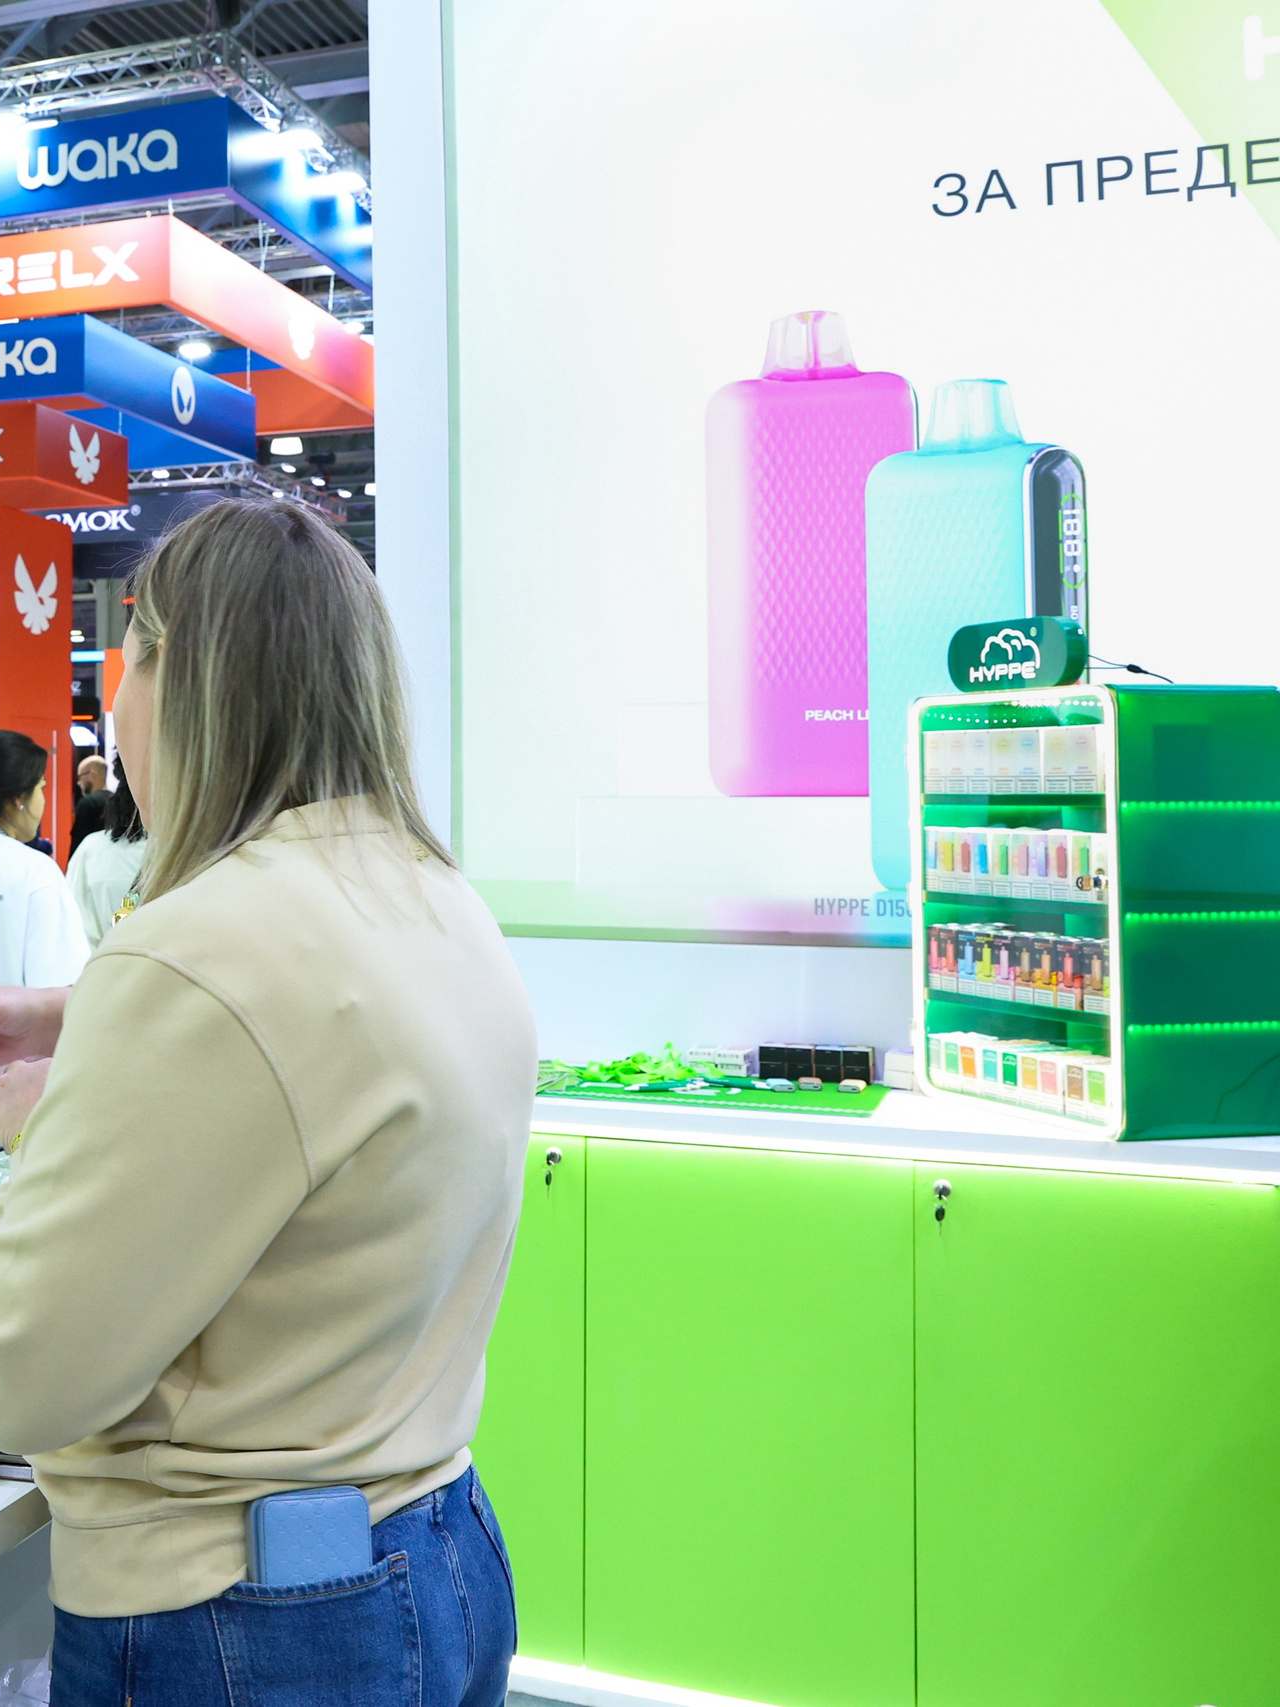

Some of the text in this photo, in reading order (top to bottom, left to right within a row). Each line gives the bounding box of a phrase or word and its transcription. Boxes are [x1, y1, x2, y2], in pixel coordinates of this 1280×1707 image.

[931, 168, 1018, 217] ЗА
[969, 661, 1037, 684] HYPPE
[804, 709, 854, 722] PEACH
[813, 897, 871, 917] HYPPE
